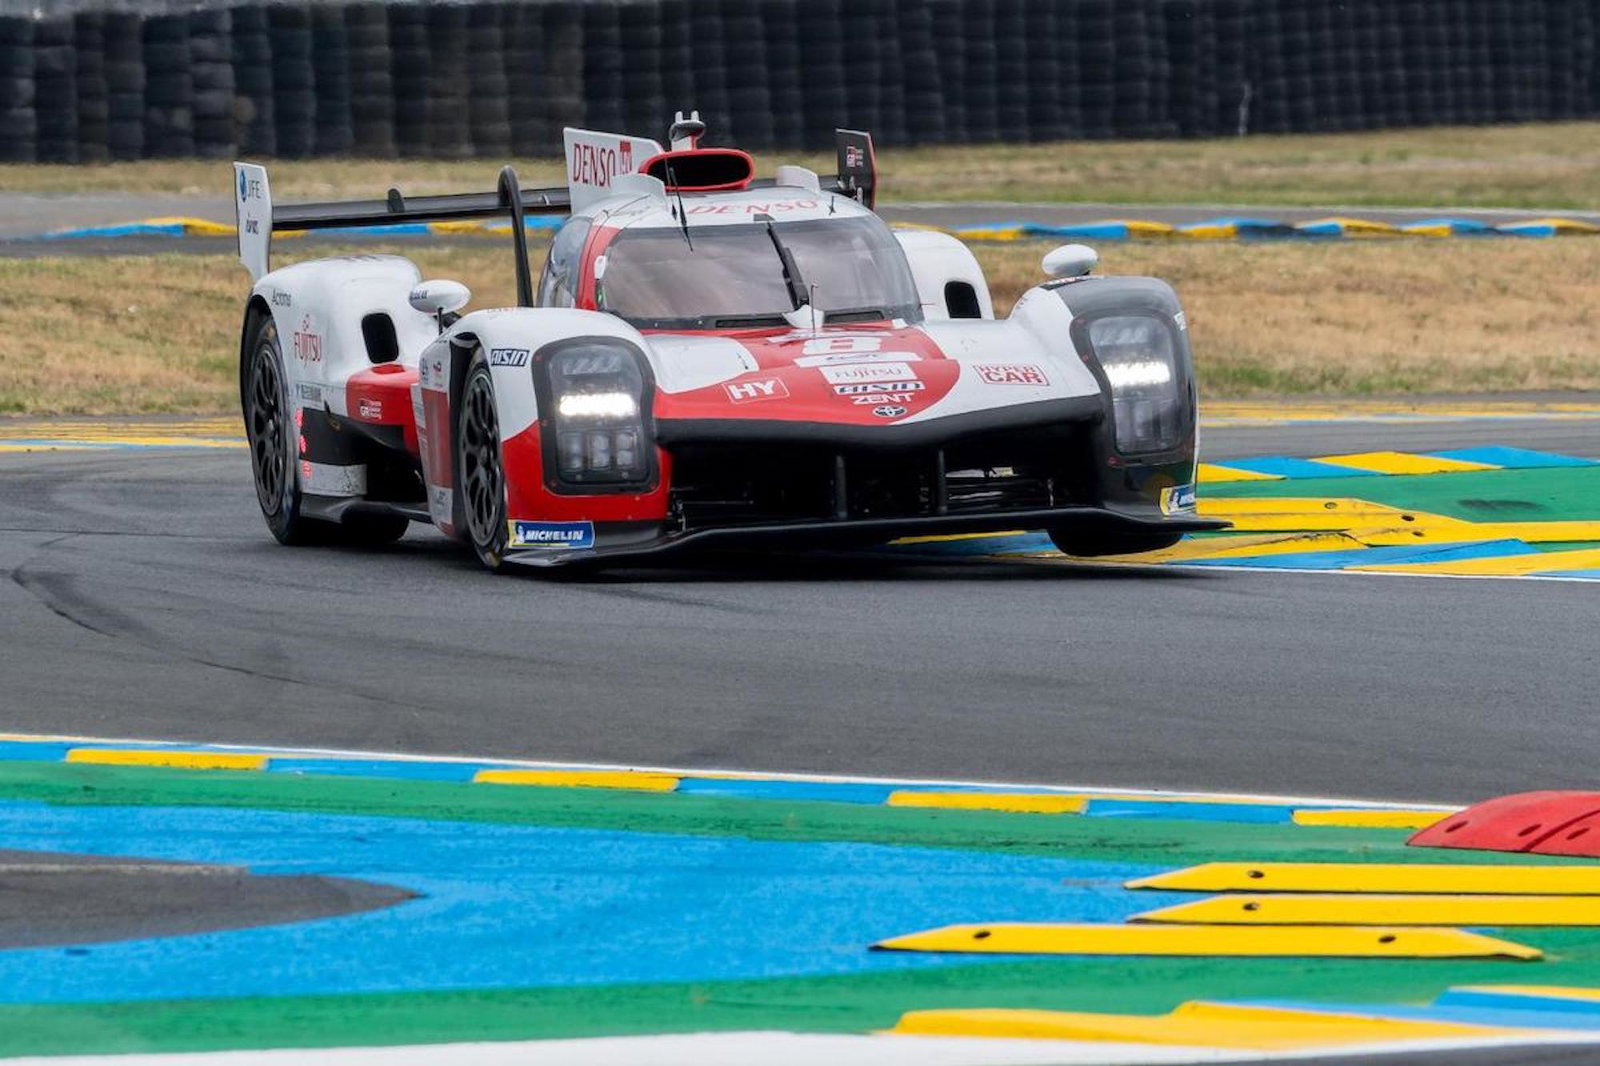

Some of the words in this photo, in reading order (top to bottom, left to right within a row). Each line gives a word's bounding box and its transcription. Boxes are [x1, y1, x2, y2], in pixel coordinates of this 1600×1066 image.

[573, 143, 616, 188] DENSO
[687, 200, 818, 214] DENSO
[294, 331, 322, 368] FUJITSU
[491, 350, 528, 366] AISIN
[834, 367, 903, 379] FUJITSU
[984, 371, 1043, 383] CAR
[727, 380, 777, 400] HY
[838, 382, 922, 394] AISIN
[850, 393, 916, 405] ZENT
[525, 529, 584, 541] MICHELIN
